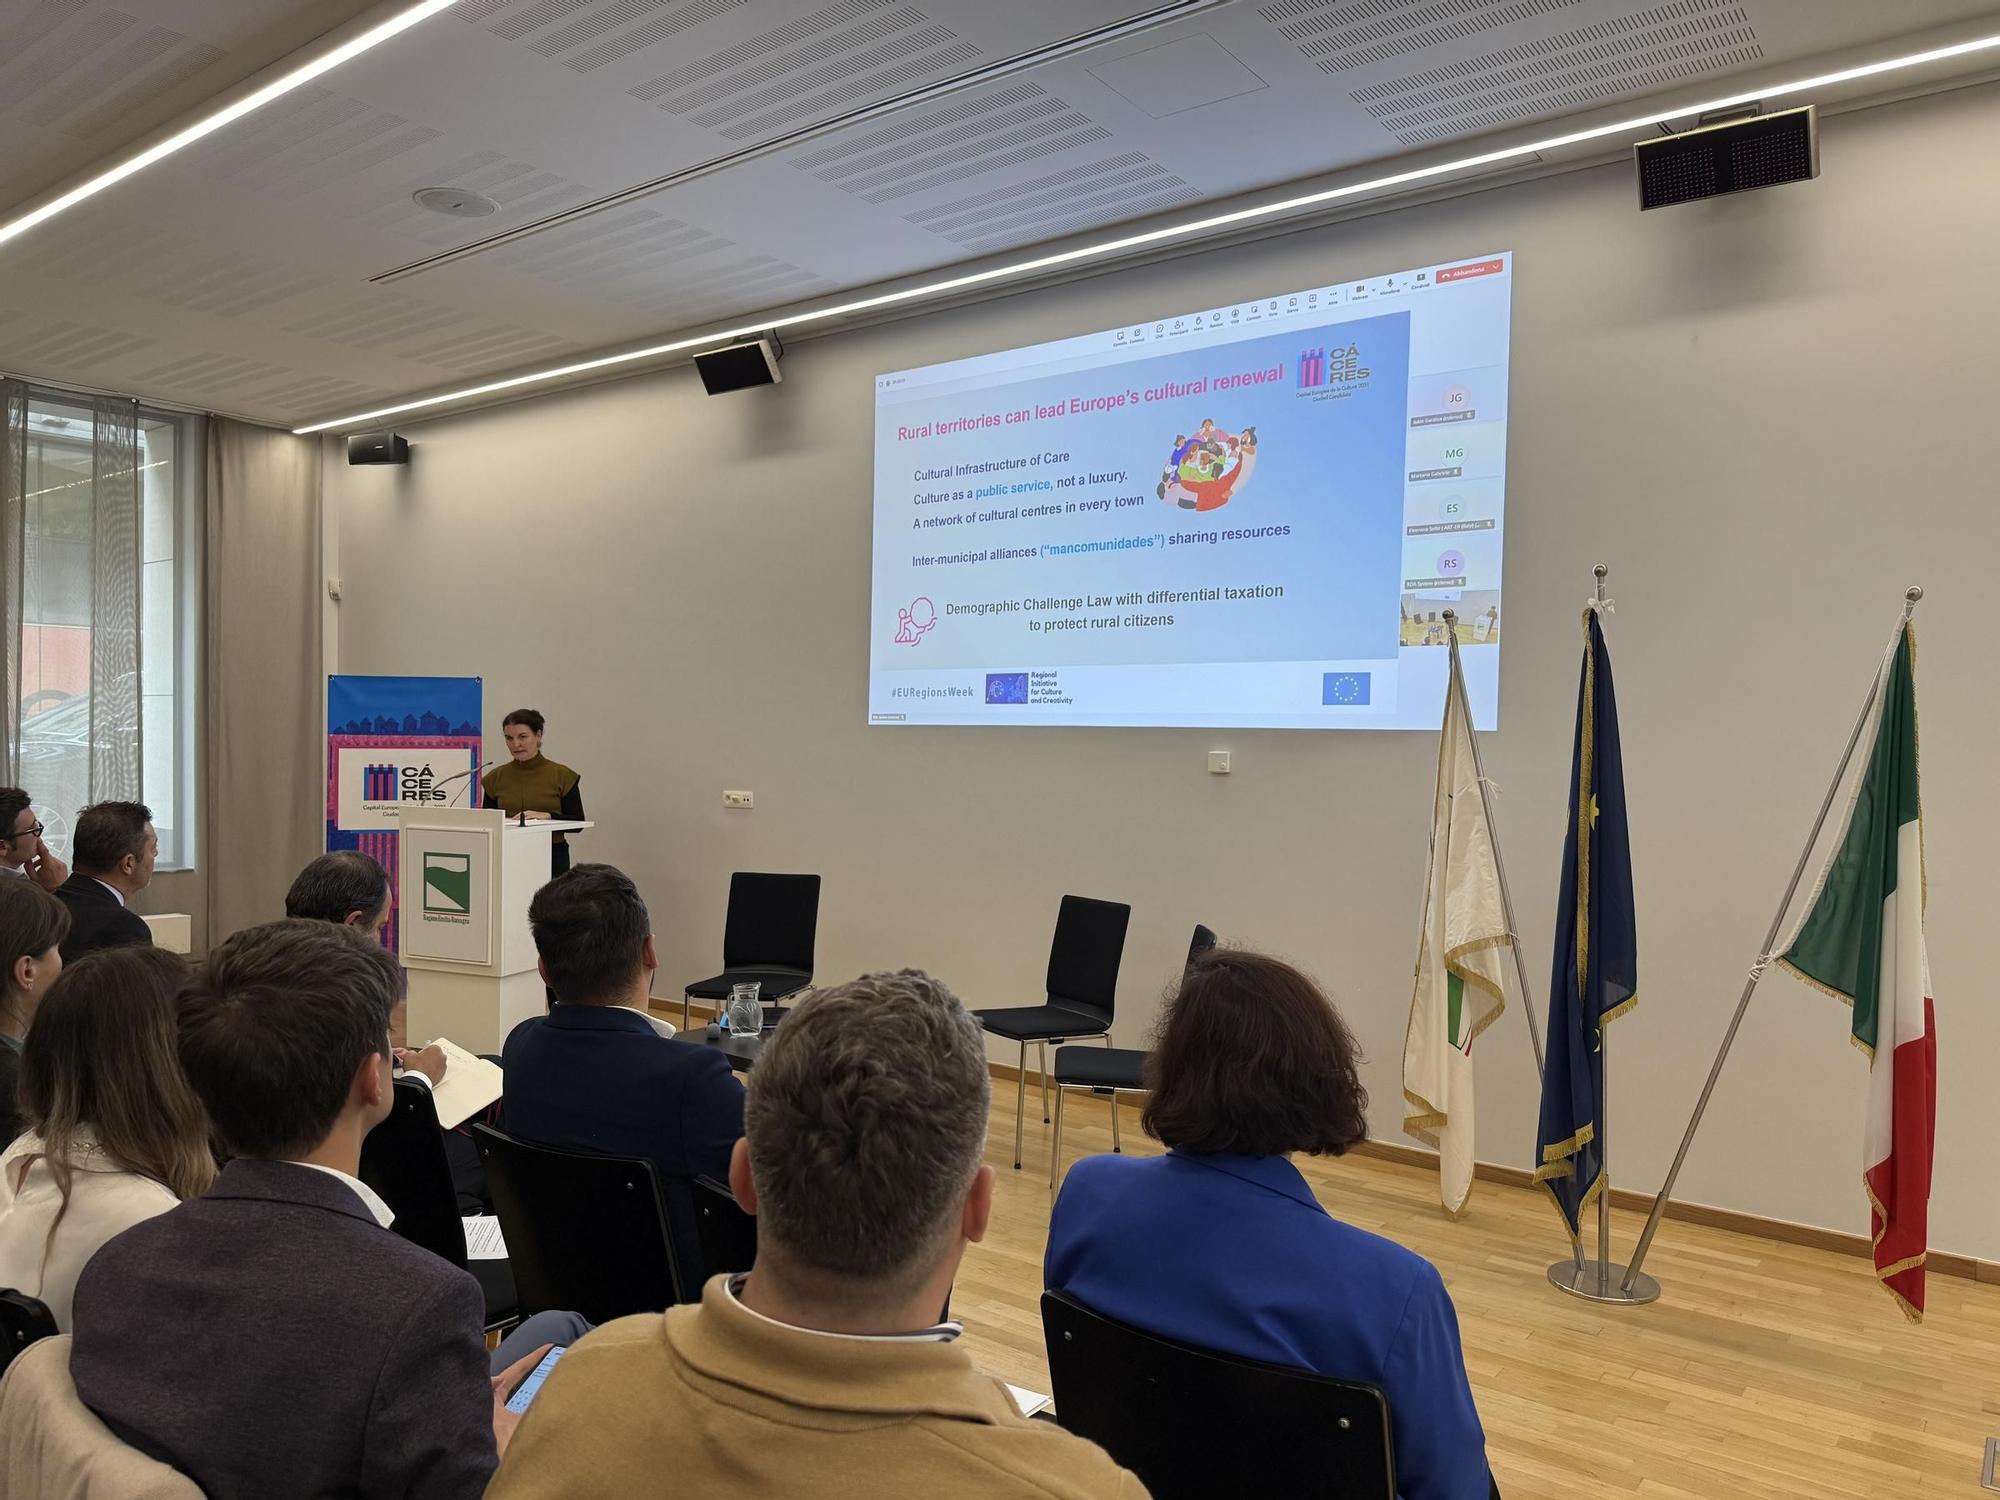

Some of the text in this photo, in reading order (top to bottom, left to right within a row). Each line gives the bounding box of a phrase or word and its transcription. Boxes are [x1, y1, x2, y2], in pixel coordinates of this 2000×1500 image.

[1330, 342, 1360, 360] CÁ
[1330, 357, 1357, 371] CE
[1330, 368, 1370, 384] RES
[898, 422, 932, 441] Rural
[935, 413, 1001, 435] territories
[1005, 409, 1030, 424] can
[1035, 400, 1065, 419] lead
[1144, 376, 1208, 401] cultural
[1213, 363, 1284, 391] renewal
[1450, 393, 1462, 403] JG
[1445, 448, 1463, 459] MG
[914, 452, 1070, 482] Cultural Infrastructure of Care
[913, 472, 1128, 505] Culture as a public service, not a luxury.
[913, 495, 1144, 529] A network of cultural centres in every town
[1447, 503, 1458, 513] ES
[912, 549, 987, 567] Inter-municipal
[990, 547, 1037, 560] alliances
[1169, 531, 1217, 545] sharing
[1221, 525, 1291, 540] resources
[1444, 559, 1457, 568] RS
[946, 585, 1284, 616] Demographic Challenge Law with differential taxation
[1029, 614, 1174, 633] to protect rural citizens
[1031, 671, 1057, 679] Regional
[891, 686, 974, 700] #EURegionsWeek
[1042, 697, 1073, 705] Creativity
[401, 763, 435, 778] CÁ
[401, 779, 432, 789] CE
[402, 790, 447, 801] RES
